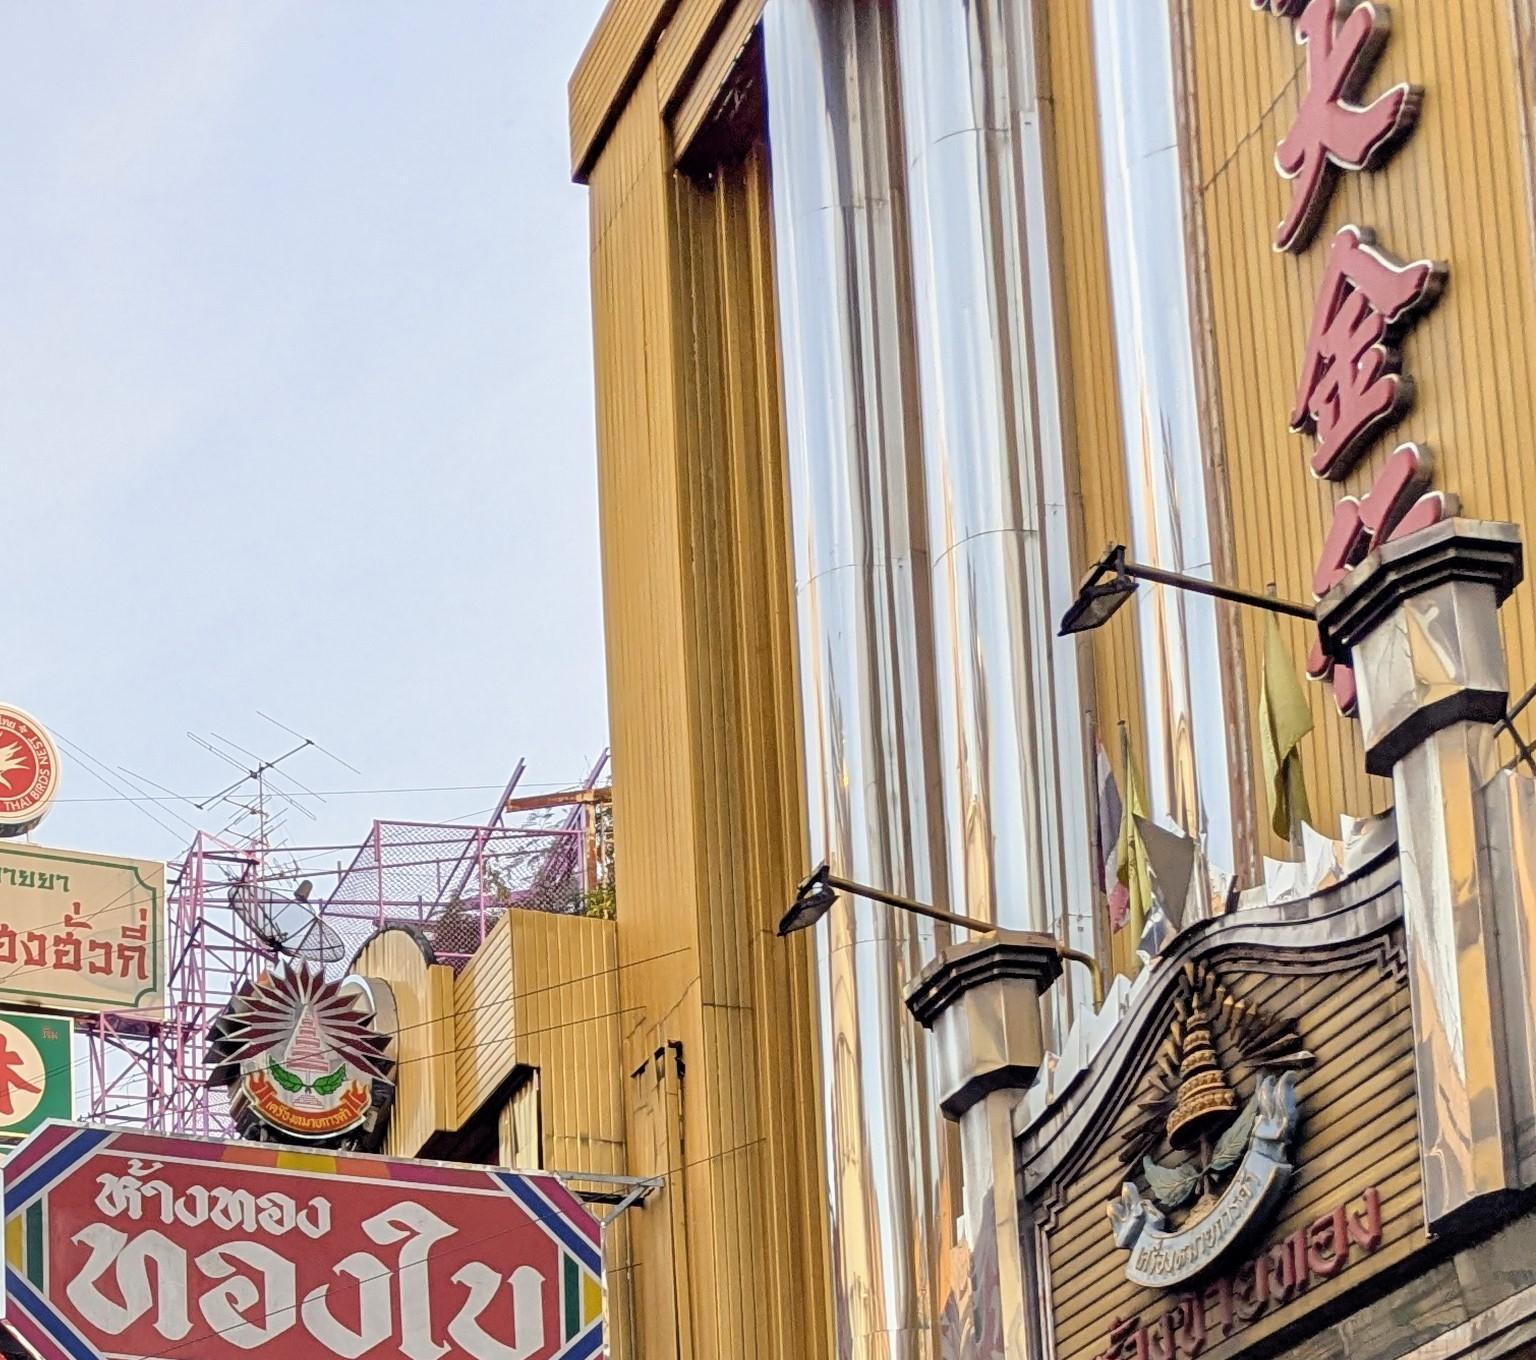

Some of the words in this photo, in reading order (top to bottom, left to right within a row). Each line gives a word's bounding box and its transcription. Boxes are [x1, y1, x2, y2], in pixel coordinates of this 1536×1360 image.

[27, 735, 49, 765] NEST
[30, 768, 50, 799] BIRDS
[4, 797, 32, 812] THAI
[93, 1159, 331, 1239] ห้างทอง
